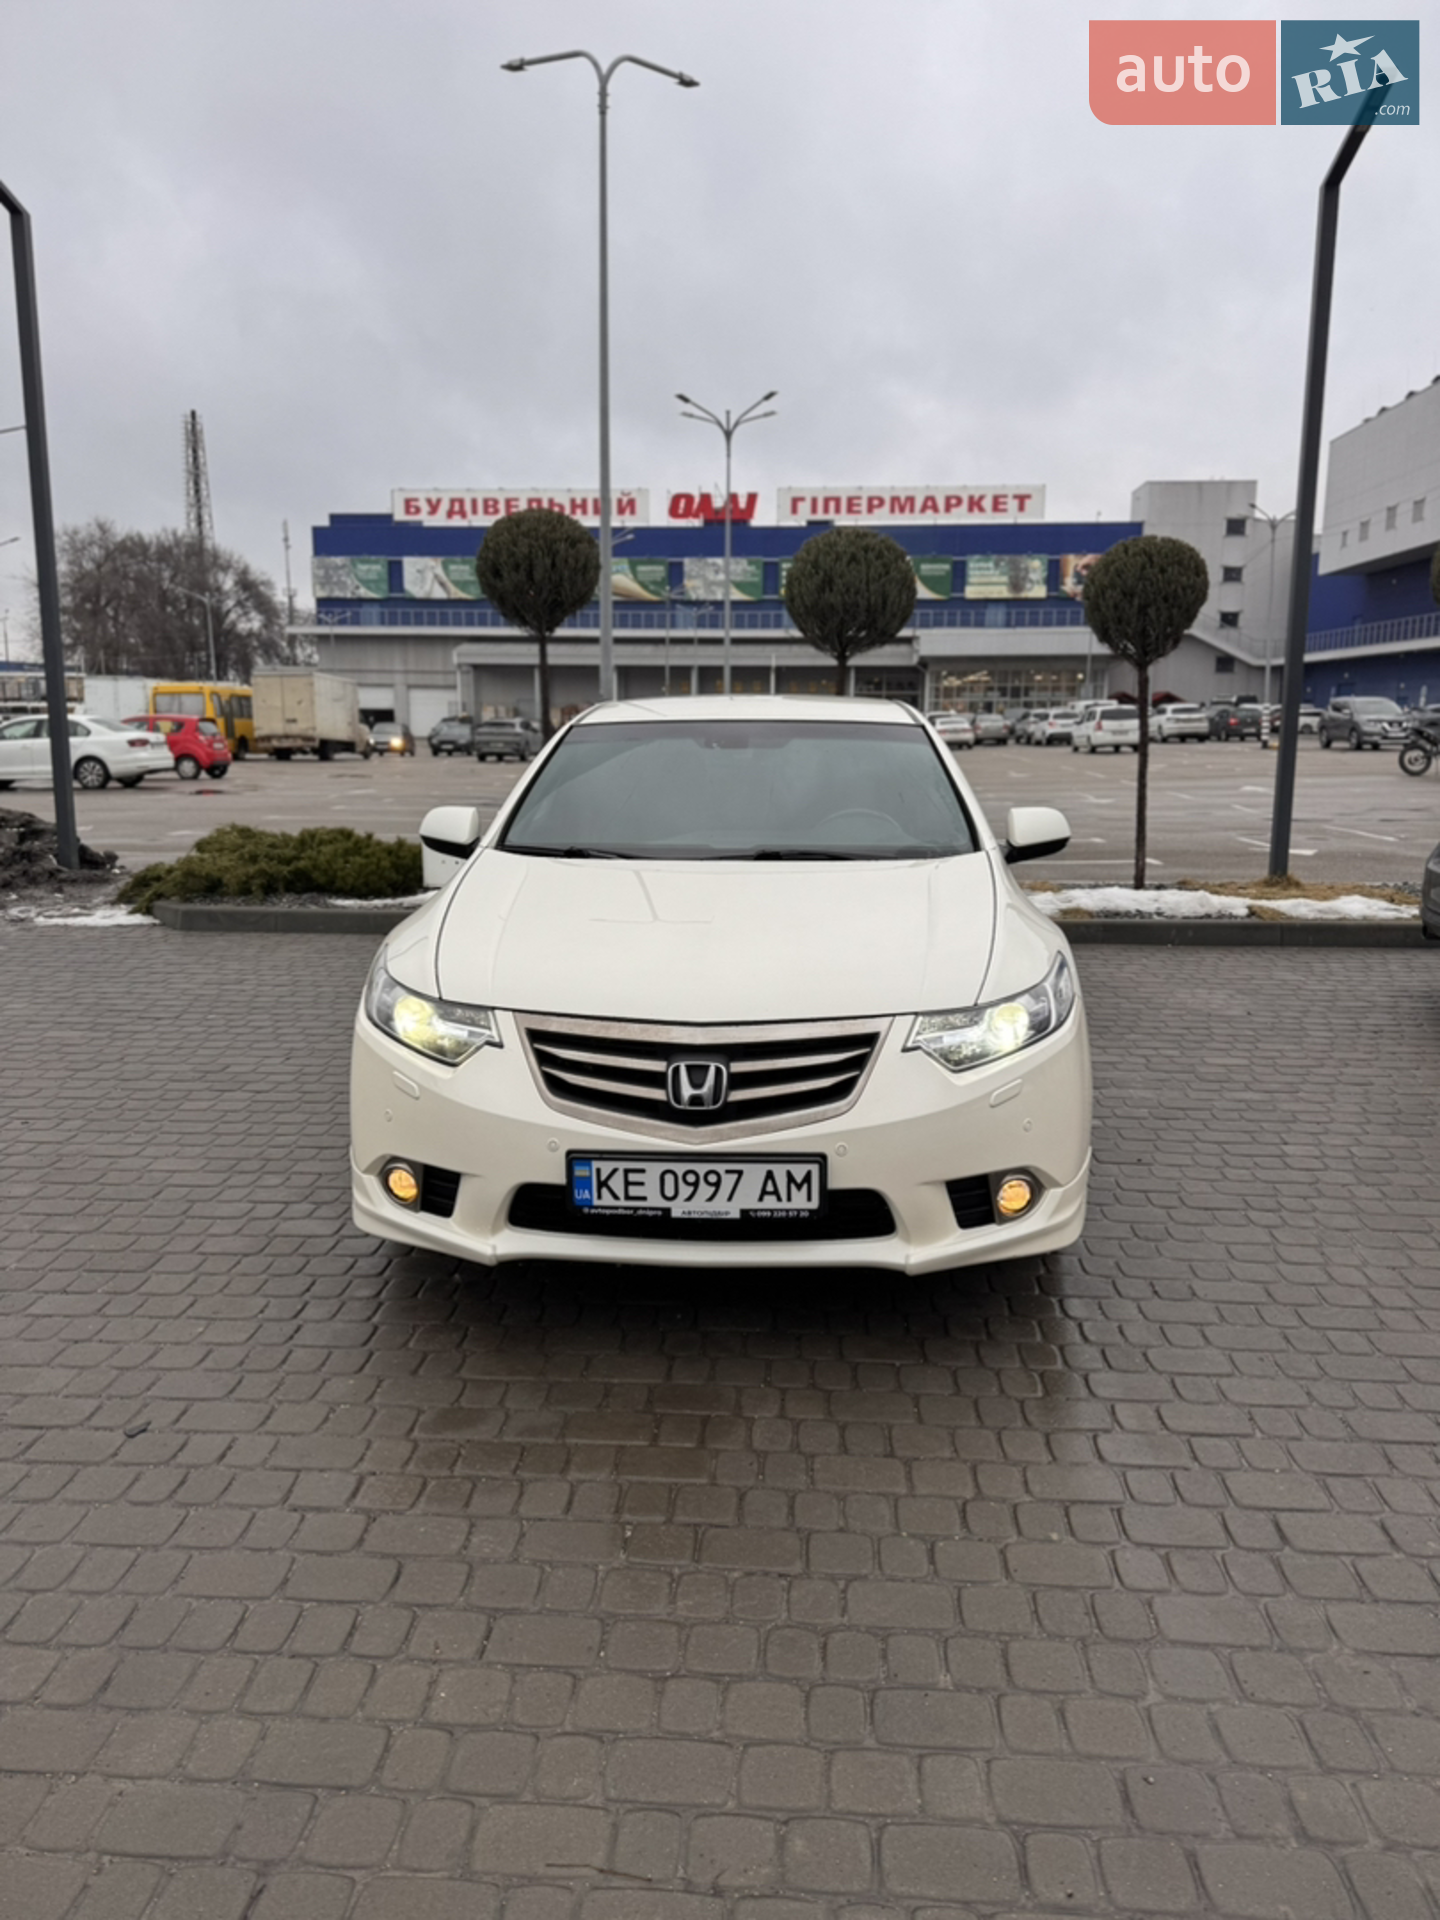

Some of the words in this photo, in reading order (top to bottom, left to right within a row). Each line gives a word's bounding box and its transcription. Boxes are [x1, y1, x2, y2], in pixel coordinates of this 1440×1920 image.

[790, 493, 1033, 516] ГІПЕРМАРКЕТ
[574, 1189, 591, 1200] UA
[595, 1167, 648, 1202] KE
[659, 1168, 745, 1203] 0997
[757, 1168, 813, 1203] AM
